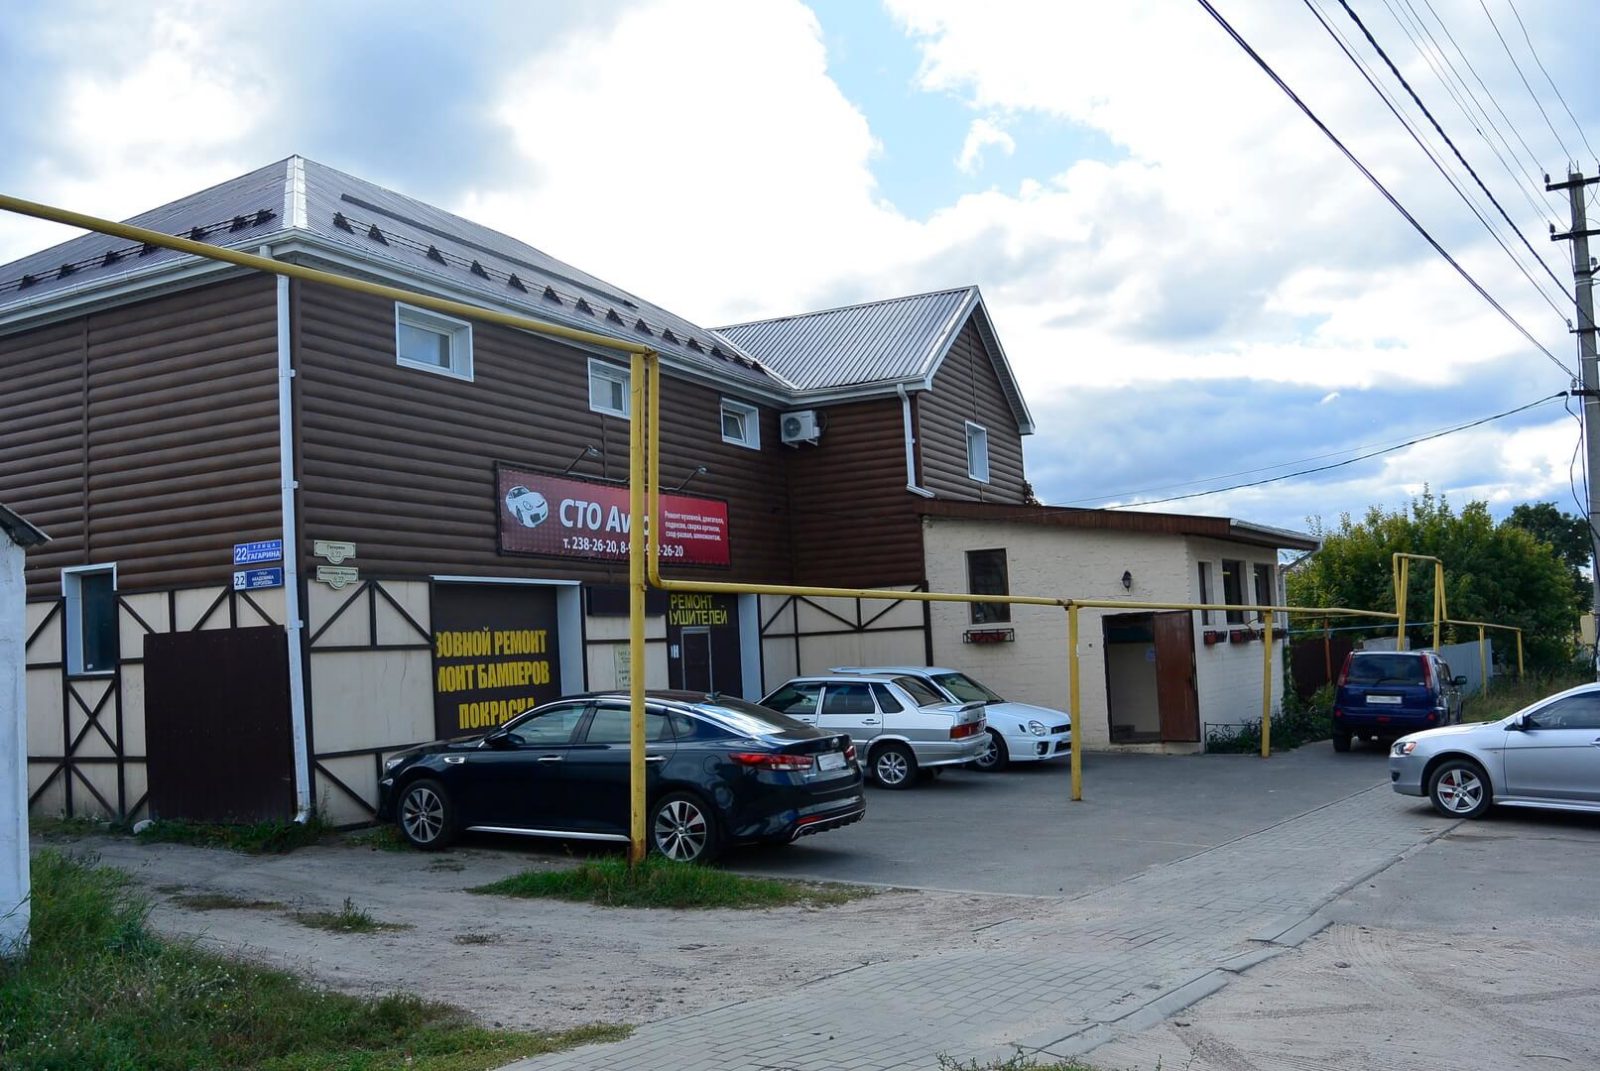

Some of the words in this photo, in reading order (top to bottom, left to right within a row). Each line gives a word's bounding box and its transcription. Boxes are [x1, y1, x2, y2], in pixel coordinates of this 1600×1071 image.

[559, 498, 602, 531] СТО
[605, 505, 650, 536] Av
[236, 547, 247, 561] 22
[572, 536, 620, 555] 238-26-20,
[247, 550, 281, 561] ГАГАРИНА
[235, 575, 245, 587] 22
[670, 594, 713, 609] РЕМОНТ
[494, 630, 547, 656] РЕМОНТ
[477, 661, 550, 689] БАМПЕРОВ
